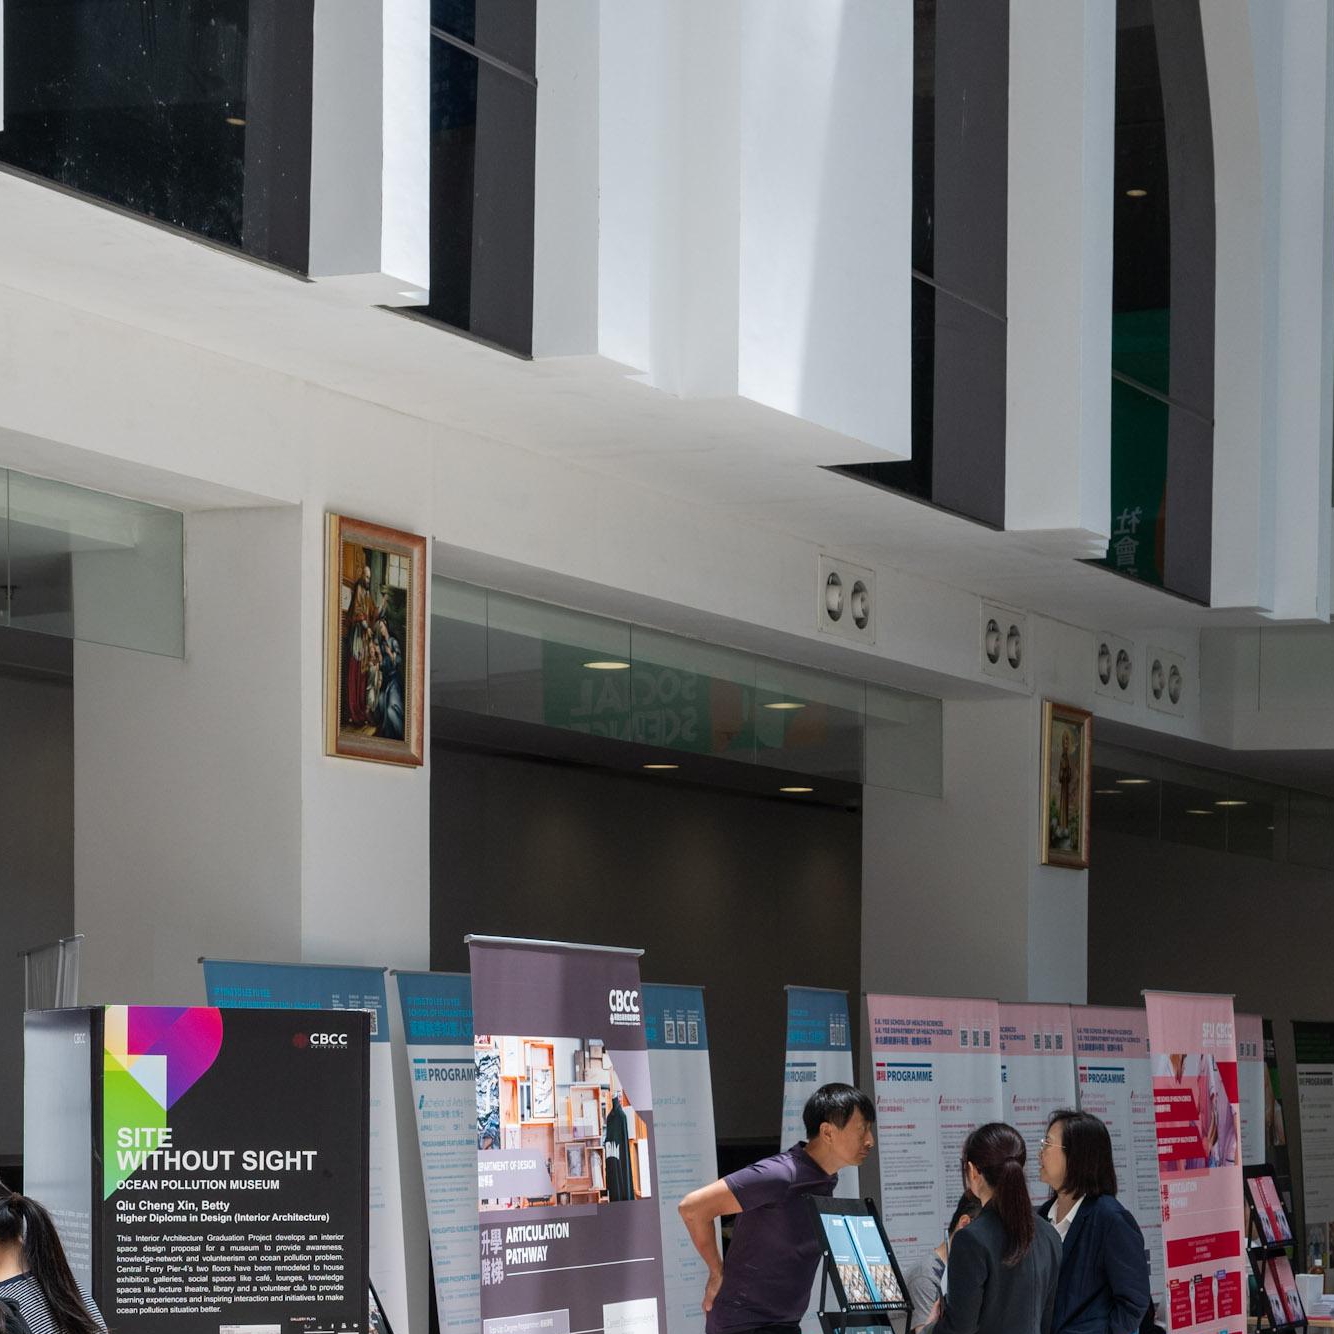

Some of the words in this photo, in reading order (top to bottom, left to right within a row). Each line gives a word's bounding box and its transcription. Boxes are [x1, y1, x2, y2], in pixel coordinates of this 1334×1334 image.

[609, 989, 640, 1013] CBCC
[309, 1033, 348, 1045] CBCC
[428, 1068, 476, 1081] PROGRAM
[887, 1070, 933, 1082] PROGRAMME
[1088, 1073, 1126, 1084] PROGRAMME
[117, 1127, 173, 1148] SITE
[116, 1150, 235, 1171] WITHOUT
[242, 1150, 318, 1171] SIGHT
[116, 1179, 159, 1190] OCEAN
[161, 1179, 227, 1190] POLLUTION
[229, 1179, 280, 1190] MUSEUM
[116, 1200, 136, 1211] Qiu
[138, 1200, 175, 1213] Cheng
[177, 1200, 198, 1212] Xin,
[201, 1200, 230, 1213] Betty
[116, 1213, 147, 1225] Higher
[149, 1213, 187, 1225] Diploma
[189, 1213, 198, 1222] in
[200, 1213, 232, 1225] Design
[234, 1213, 270, 1223] (Interior
[272, 1213, 330, 1223] Architecture)
[116, 1234, 132, 1242] This
[135, 1234, 159, 1242] Interior
[162, 1234, 203, 1242] Architecture
[207, 1234, 245, 1242] Graduation
[248, 1234, 272, 1243] Project
[275, 1233, 305, 1243] develops
[505, 1222, 570, 1244] ARTICULATION
[481, 1228, 503, 1256] 升學
[505, 1246, 548, 1266] PATHWAY
